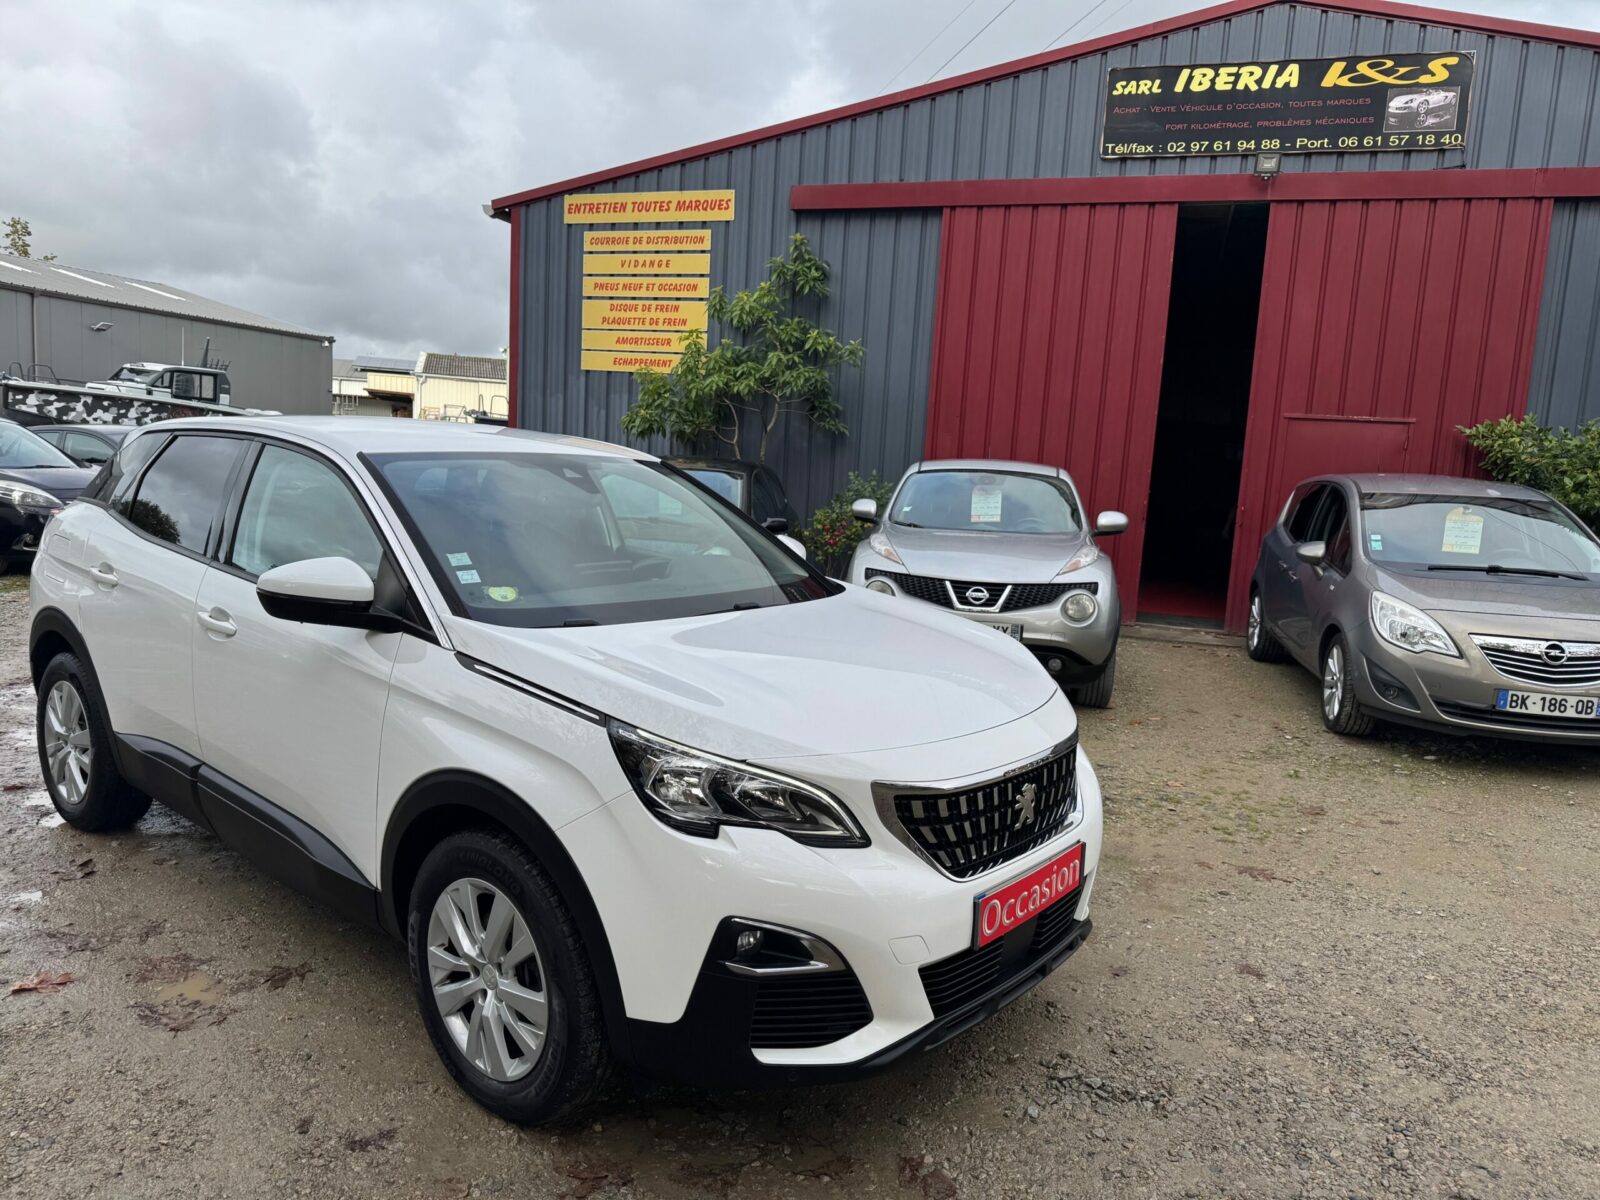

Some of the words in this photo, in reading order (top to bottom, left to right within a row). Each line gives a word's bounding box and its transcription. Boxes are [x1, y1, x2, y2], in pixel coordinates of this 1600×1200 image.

[1112, 79, 1162, 95] SARL
[1175, 64, 1300, 92] IBERIA
[1326, 97, 1372, 106] MARQUES
[1315, 116, 1375, 126] MÉCANIQUES
[1105, 143, 1153, 154] Tél/fax
[1167, 142, 1185, 152] 02
[1190, 141, 1209, 151] 97
[1213, 140, 1231, 151] 61
[1237, 140, 1256, 150] 94
[1261, 139, 1281, 149] 88
[1296, 137, 1332, 148] Port.
[1338, 136, 1358, 147] 06
[1363, 136, 1382, 146] 61
[1388, 135, 1409, 146] 57
[1416, 134, 1435, 145] 18
[1440, 133, 1462, 144] 40
[567, 202, 628, 214] ENTRETIEN
[631, 200, 672, 213] TOUTES
[675, 199, 731, 212] MARQUES
[590, 237, 630, 246] COURROIE
[632, 236, 643, 245] DE
[646, 235, 705, 245] DISTRIBUTION
[593, 282, 620, 291] PNEUS
[621, 283, 644, 292] NEUF
[645, 283, 656, 292] ET
[657, 283, 698, 292] OCCASION
[609, 303, 639, 312] DISQUE
[641, 303, 652, 313] DE
[654, 304, 680, 313] FREIN
[601, 316, 646, 325] PLAQUETTE
[649, 317, 660, 326] DE
[662, 318, 688, 327] FREIN
[615, 336, 672, 347] AMORTISSEUR
[612, 357, 673, 368] ECHAPPEMENT
[983, 859, 1080, 937] Occasion
